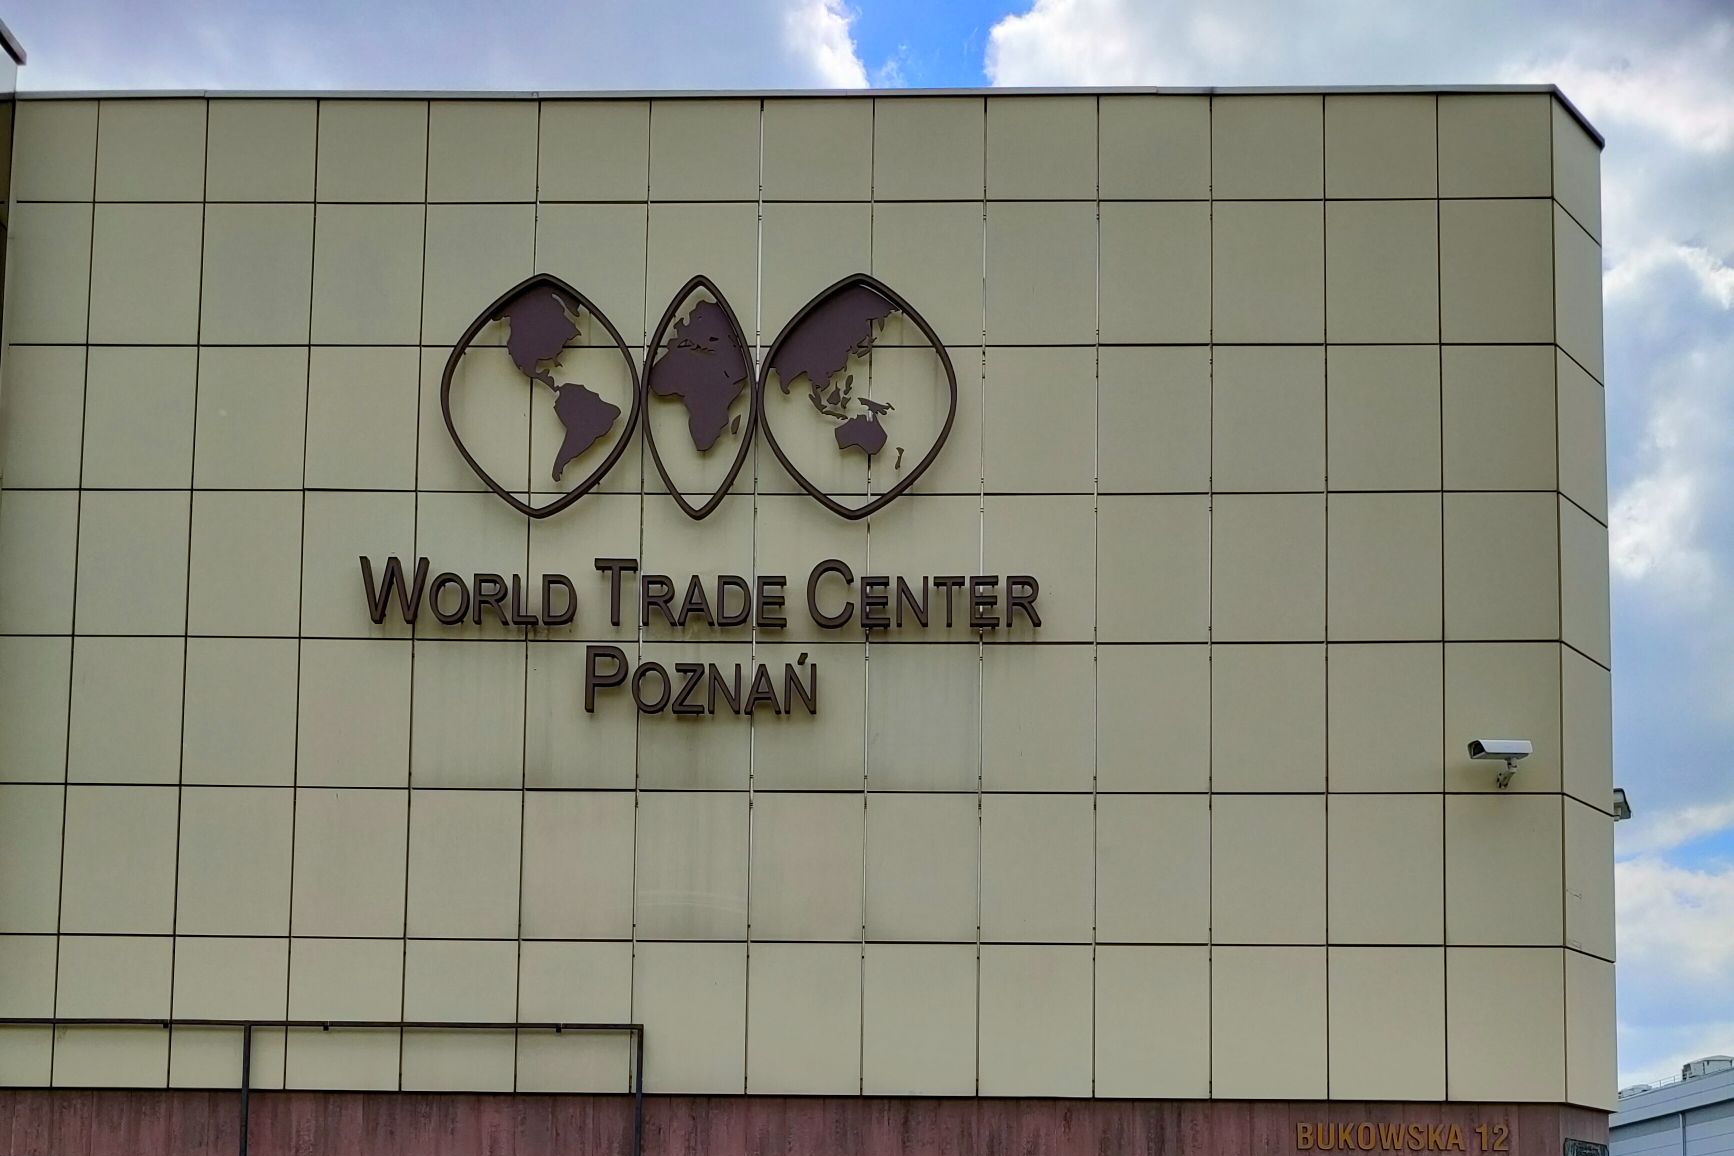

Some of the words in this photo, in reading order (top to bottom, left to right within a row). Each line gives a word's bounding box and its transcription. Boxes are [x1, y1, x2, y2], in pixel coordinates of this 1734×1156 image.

[360, 556, 577, 626] WORLD
[594, 558, 788, 628] TRADE
[807, 559, 1042, 630] CENTER
[584, 645, 817, 715] POZNAŃ
[1296, 1121, 1466, 1151] BUKOWSKA
[1476, 1123, 1510, 1151] 12
